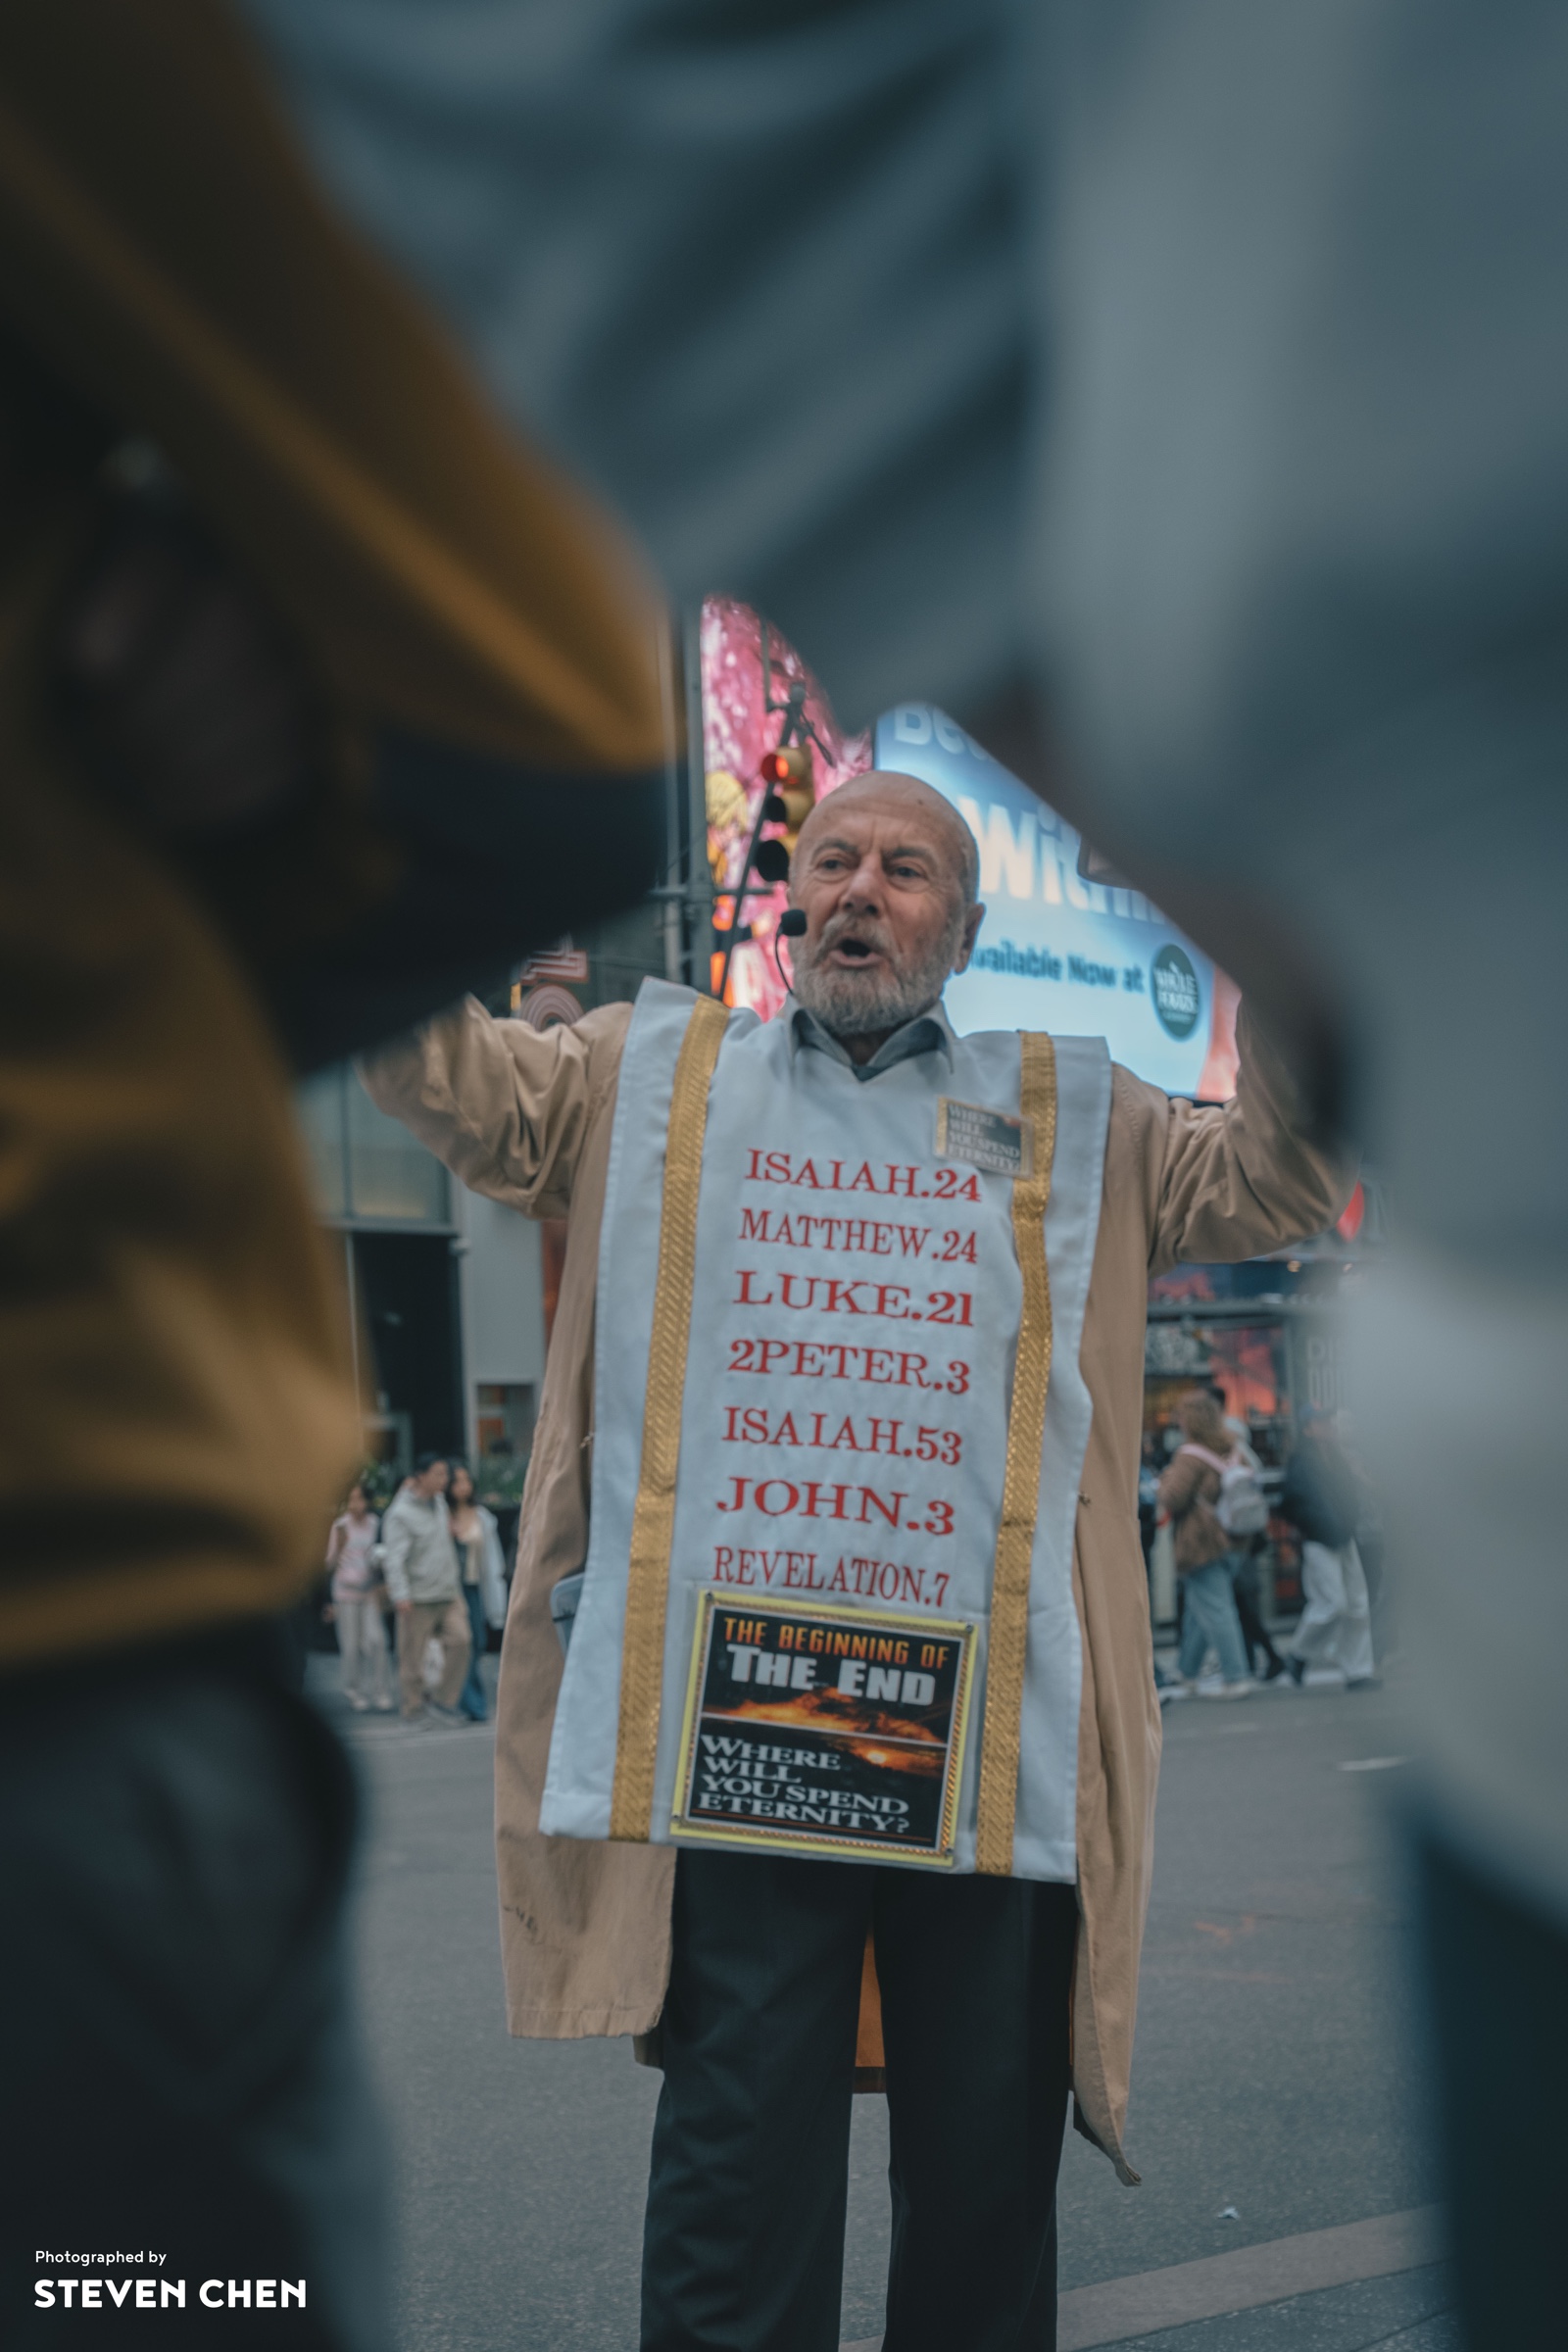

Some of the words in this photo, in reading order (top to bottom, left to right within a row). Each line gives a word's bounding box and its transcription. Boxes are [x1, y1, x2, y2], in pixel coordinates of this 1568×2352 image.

[970, 936, 1062, 982] vailable
[1067, 953, 1116, 988] Now
[745, 1148, 982, 1202] ISAIAH.24
[738, 1207, 978, 1264] MATTHEW.24
[733, 1270, 974, 1327] LUKE.21
[727, 1338, 970, 1394] 2PETER.3
[721, 1406, 963, 1466] ISAIAH.53
[716, 1476, 955, 1537] JOHN.3
[711, 1545, 951, 1607] REVELATION.7
[724, 1617, 768, 1646] THE
[779, 1625, 910, 1665] BEGINNING
[920, 1643, 951, 1670] OF
[726, 1643, 818, 1690] THE
[837, 1658, 936, 1706] END
[700, 1734, 842, 1771] WHERE
[704, 1756, 803, 1784] WILL
[697, 1791, 910, 1834] ETERNITY?
[702, 1774, 781, 1799] YOU
[784, 1785, 910, 1815] SPEND
